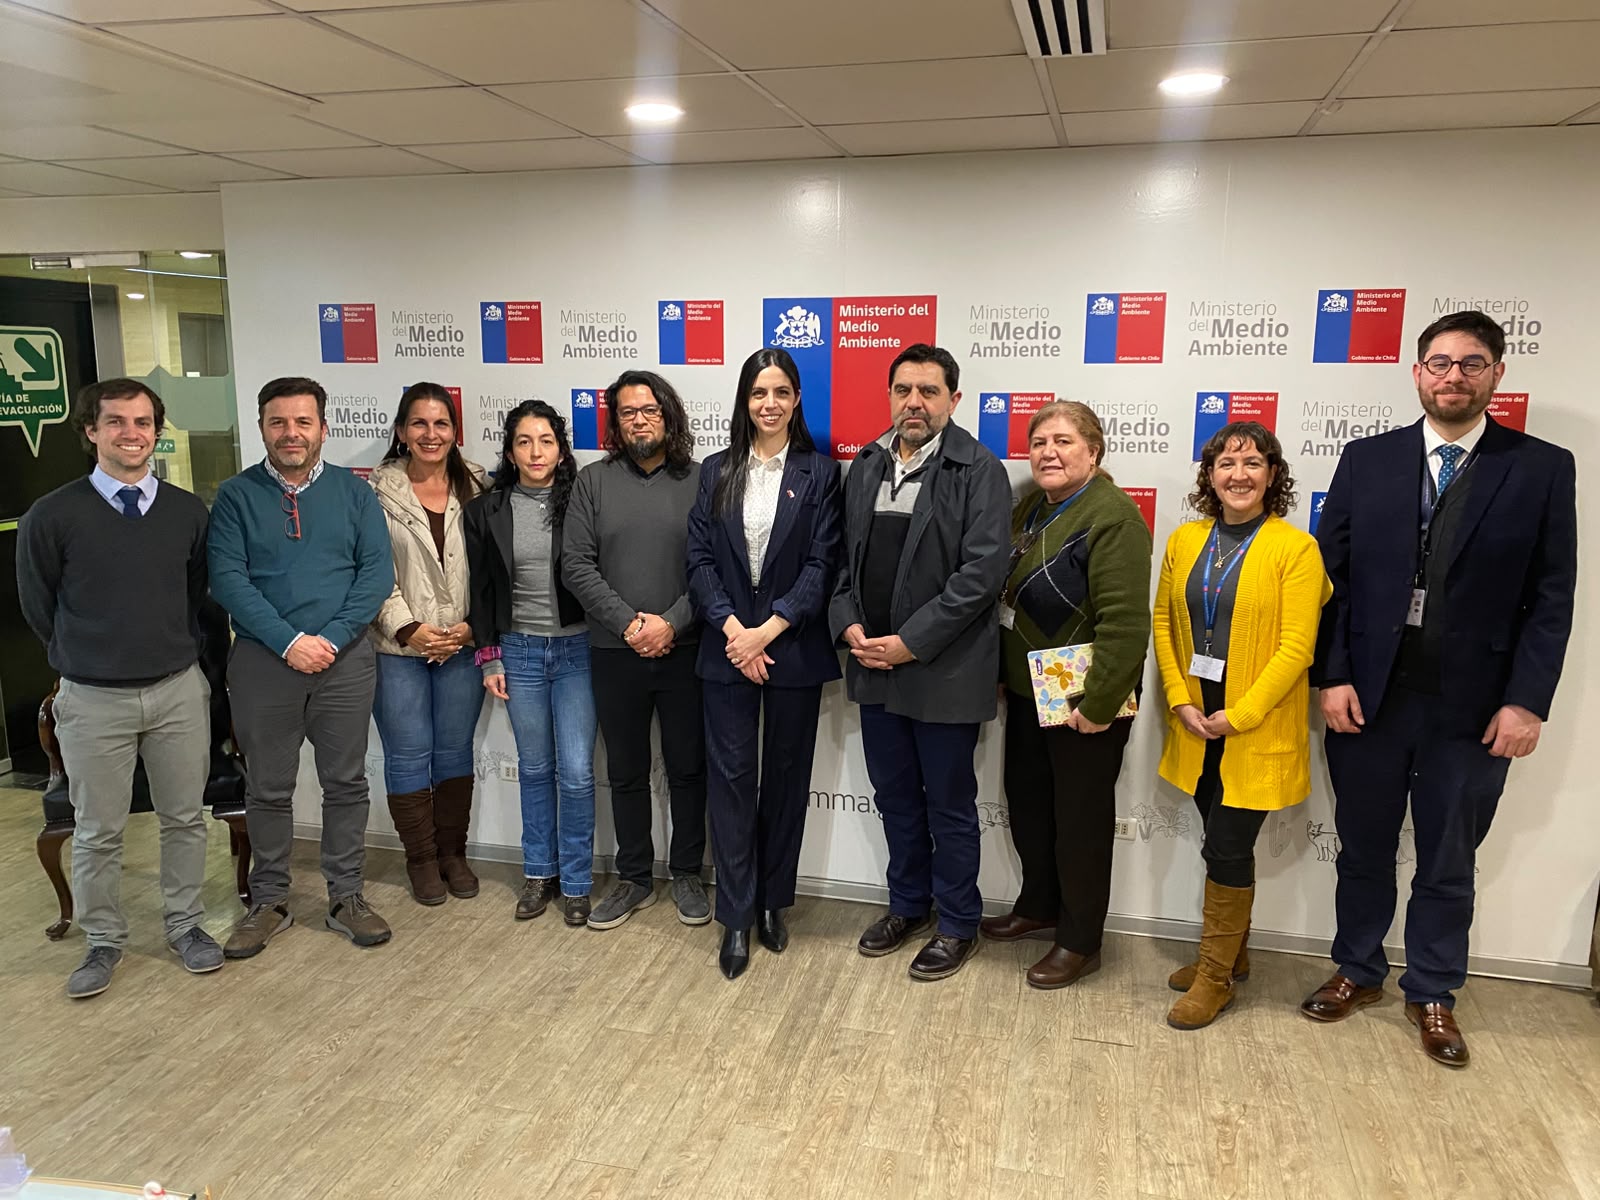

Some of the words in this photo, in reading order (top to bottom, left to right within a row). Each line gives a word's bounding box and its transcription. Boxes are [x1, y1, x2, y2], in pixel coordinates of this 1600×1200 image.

[839, 304, 905, 317] Ministerio
[908, 303, 929, 316] del
[970, 303, 1050, 320] Ministerio
[1189, 300, 1277, 317] Ministerio
[1433, 296, 1529, 313] Ministerio
[392, 310, 454, 324] Ministerio
[560, 309, 627, 324] Ministerio
[839, 320, 879, 333] Medio
[969, 322, 988, 335] del
[990, 321, 1062, 341] Medio
[1188, 319, 1208, 332] del
[1211, 318, 1289, 338] Medio
[1500, 315, 1541, 336] dio
[392, 325, 407, 337] del
[409, 325, 464, 343] Medio
[560, 325, 576, 337] del
[578, 325, 638, 343] Medio
[838, 336, 901, 348] Ambiente
[394, 343, 465, 358] Ambiente
[562, 344, 638, 359] Ambiente
[969, 342, 1061, 358] Ambiente
[1188, 339, 1288, 356] Ambiente
[0, 392, 13, 403] ÍA
[15, 394, 29, 403] DE
[326, 393, 378, 406] inisterio
[480, 395, 524, 409] Minist
[684, 398, 721, 412] sterio
[326, 408, 334, 418] el
[335, 408, 388, 424] Medio
[480, 410, 496, 421] del
[1303, 401, 1393, 417] Ministerio
[690, 414, 731, 431] edio
[1099, 417, 1170, 436] Medio
[1301, 419, 1322, 432] del
[692, 432, 731, 446] iente
[1107, 437, 1169, 453] biente
[837, 443, 864, 453] Gobi
[808, 791, 883, 820] mma.
